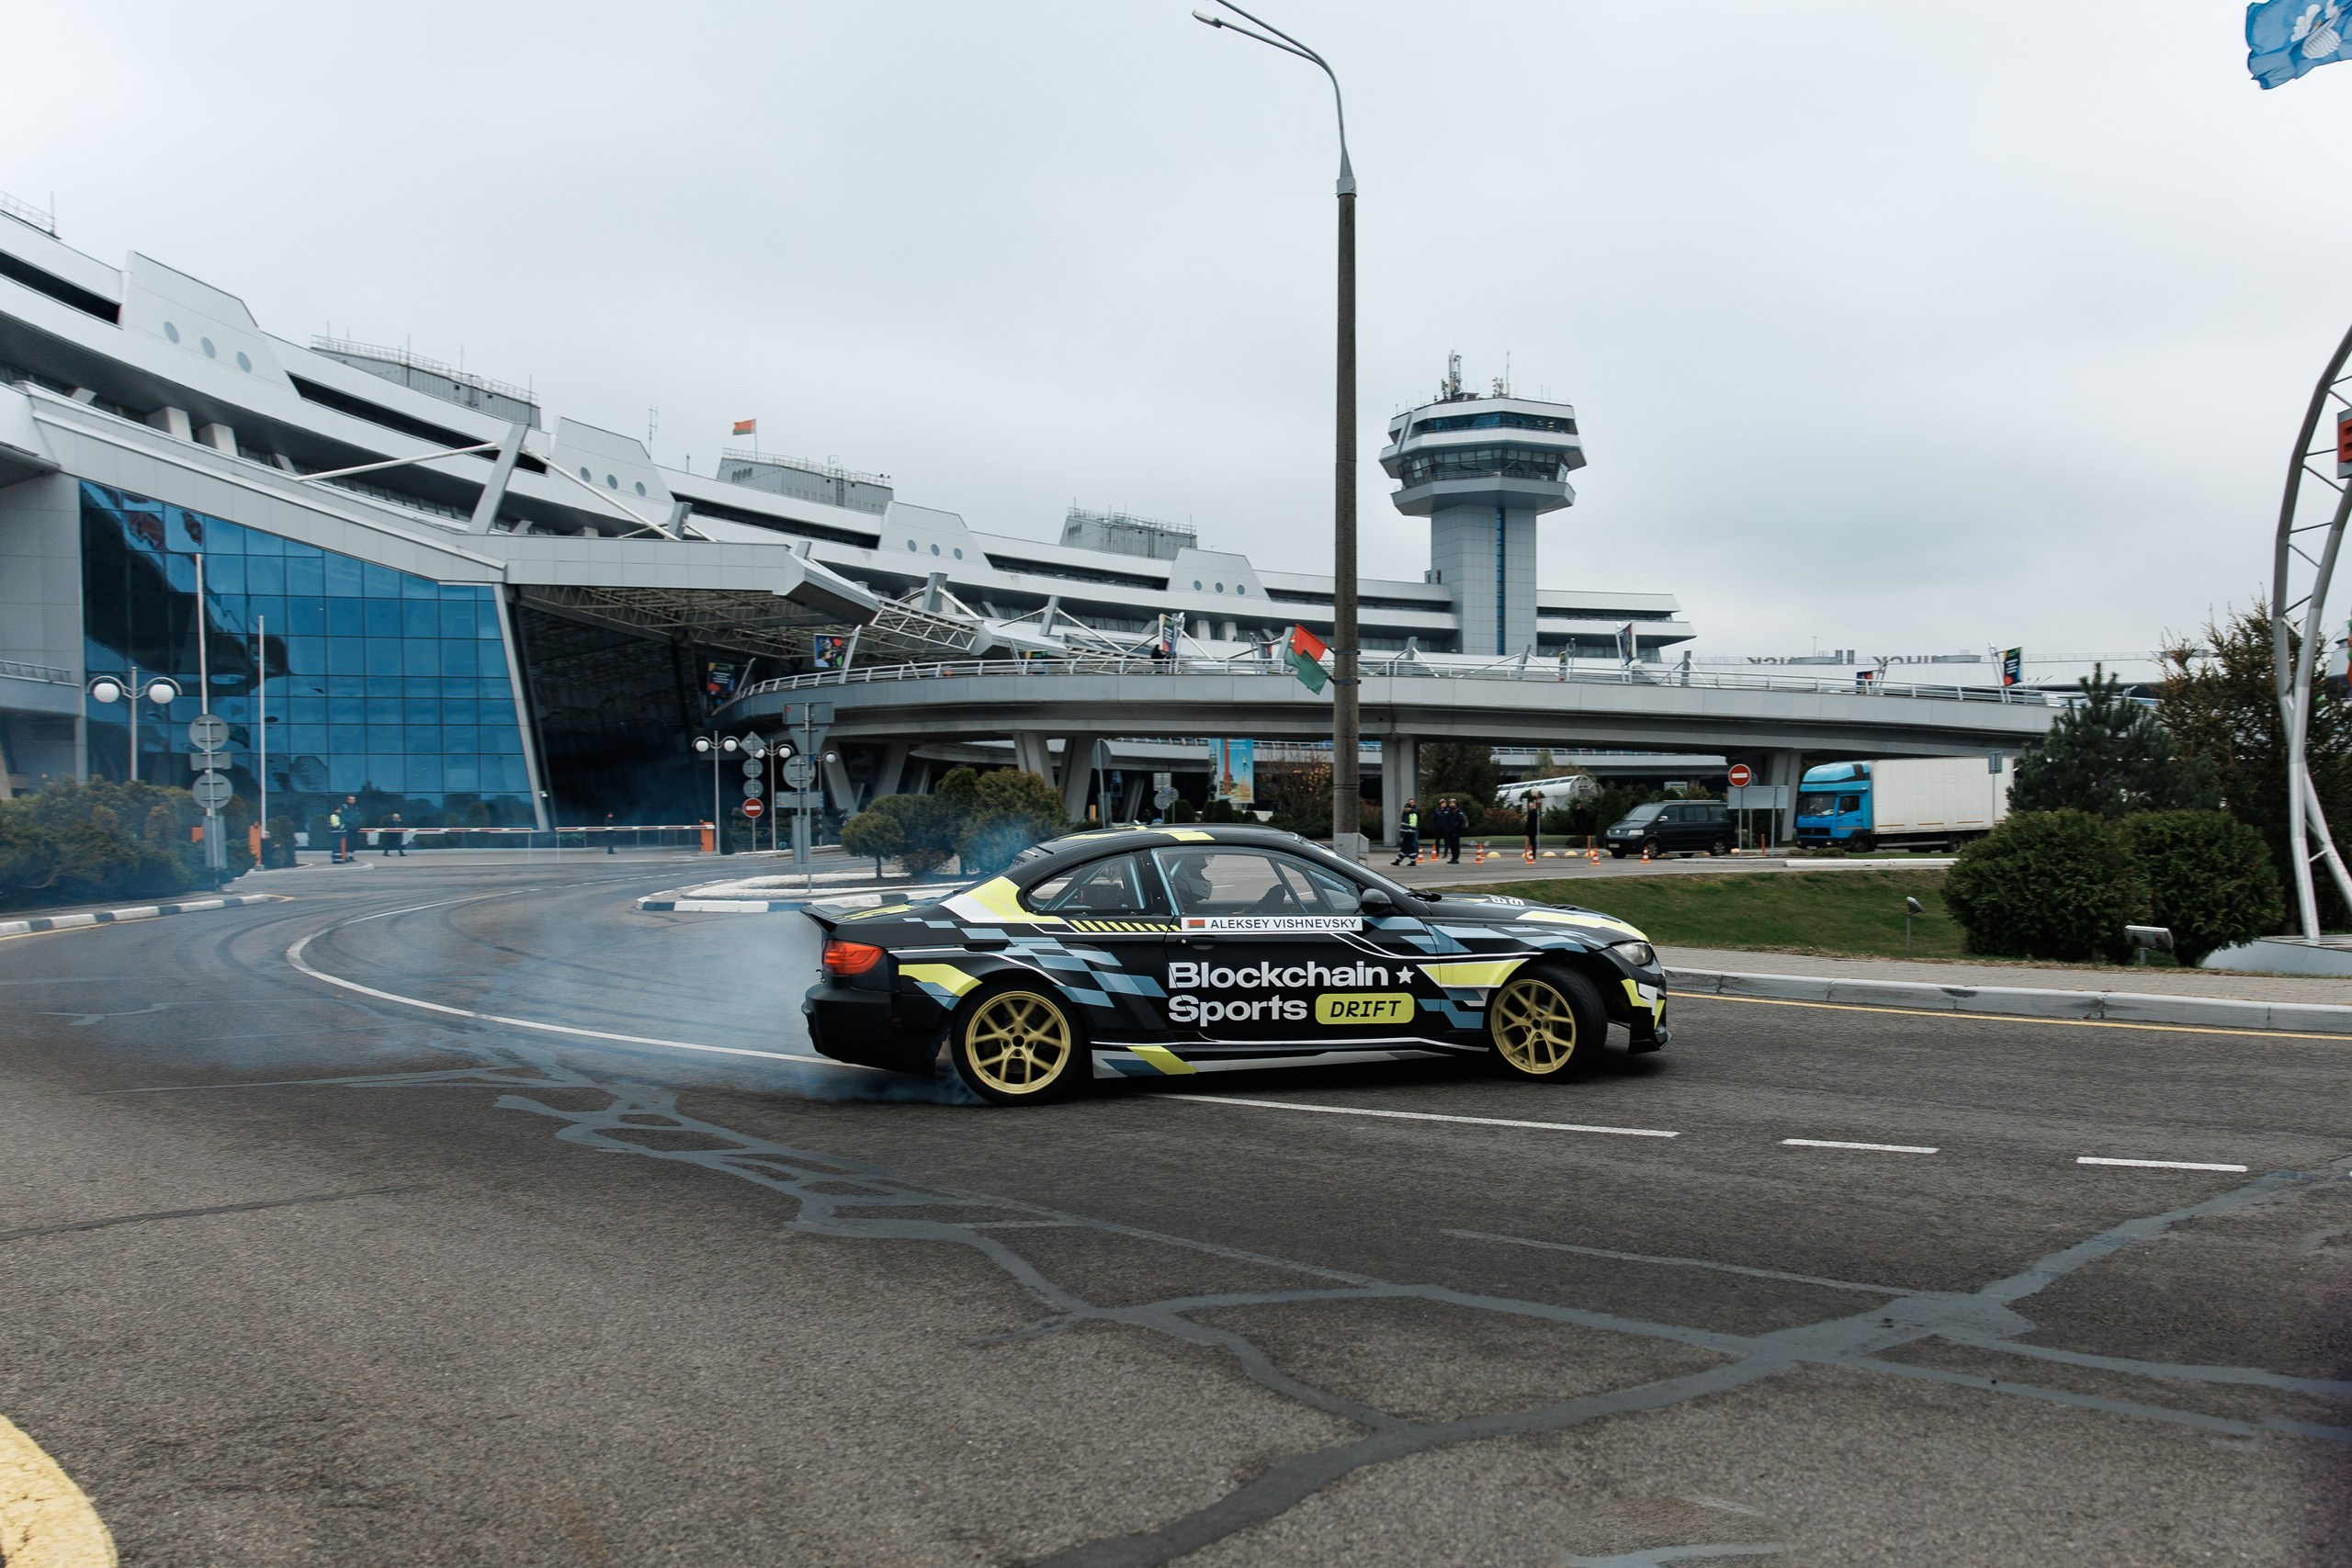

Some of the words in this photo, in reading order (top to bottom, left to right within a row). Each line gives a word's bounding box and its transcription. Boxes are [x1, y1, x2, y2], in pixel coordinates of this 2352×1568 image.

[1210, 919, 1270, 929] ALEKSEY
[1272, 919, 1356, 929] VISHNEVSKY
[1169, 961, 1389, 988] Blockchain
[1169, 995, 1307, 1027] Sports
[1330, 1000, 1401, 1018] DRIFT
